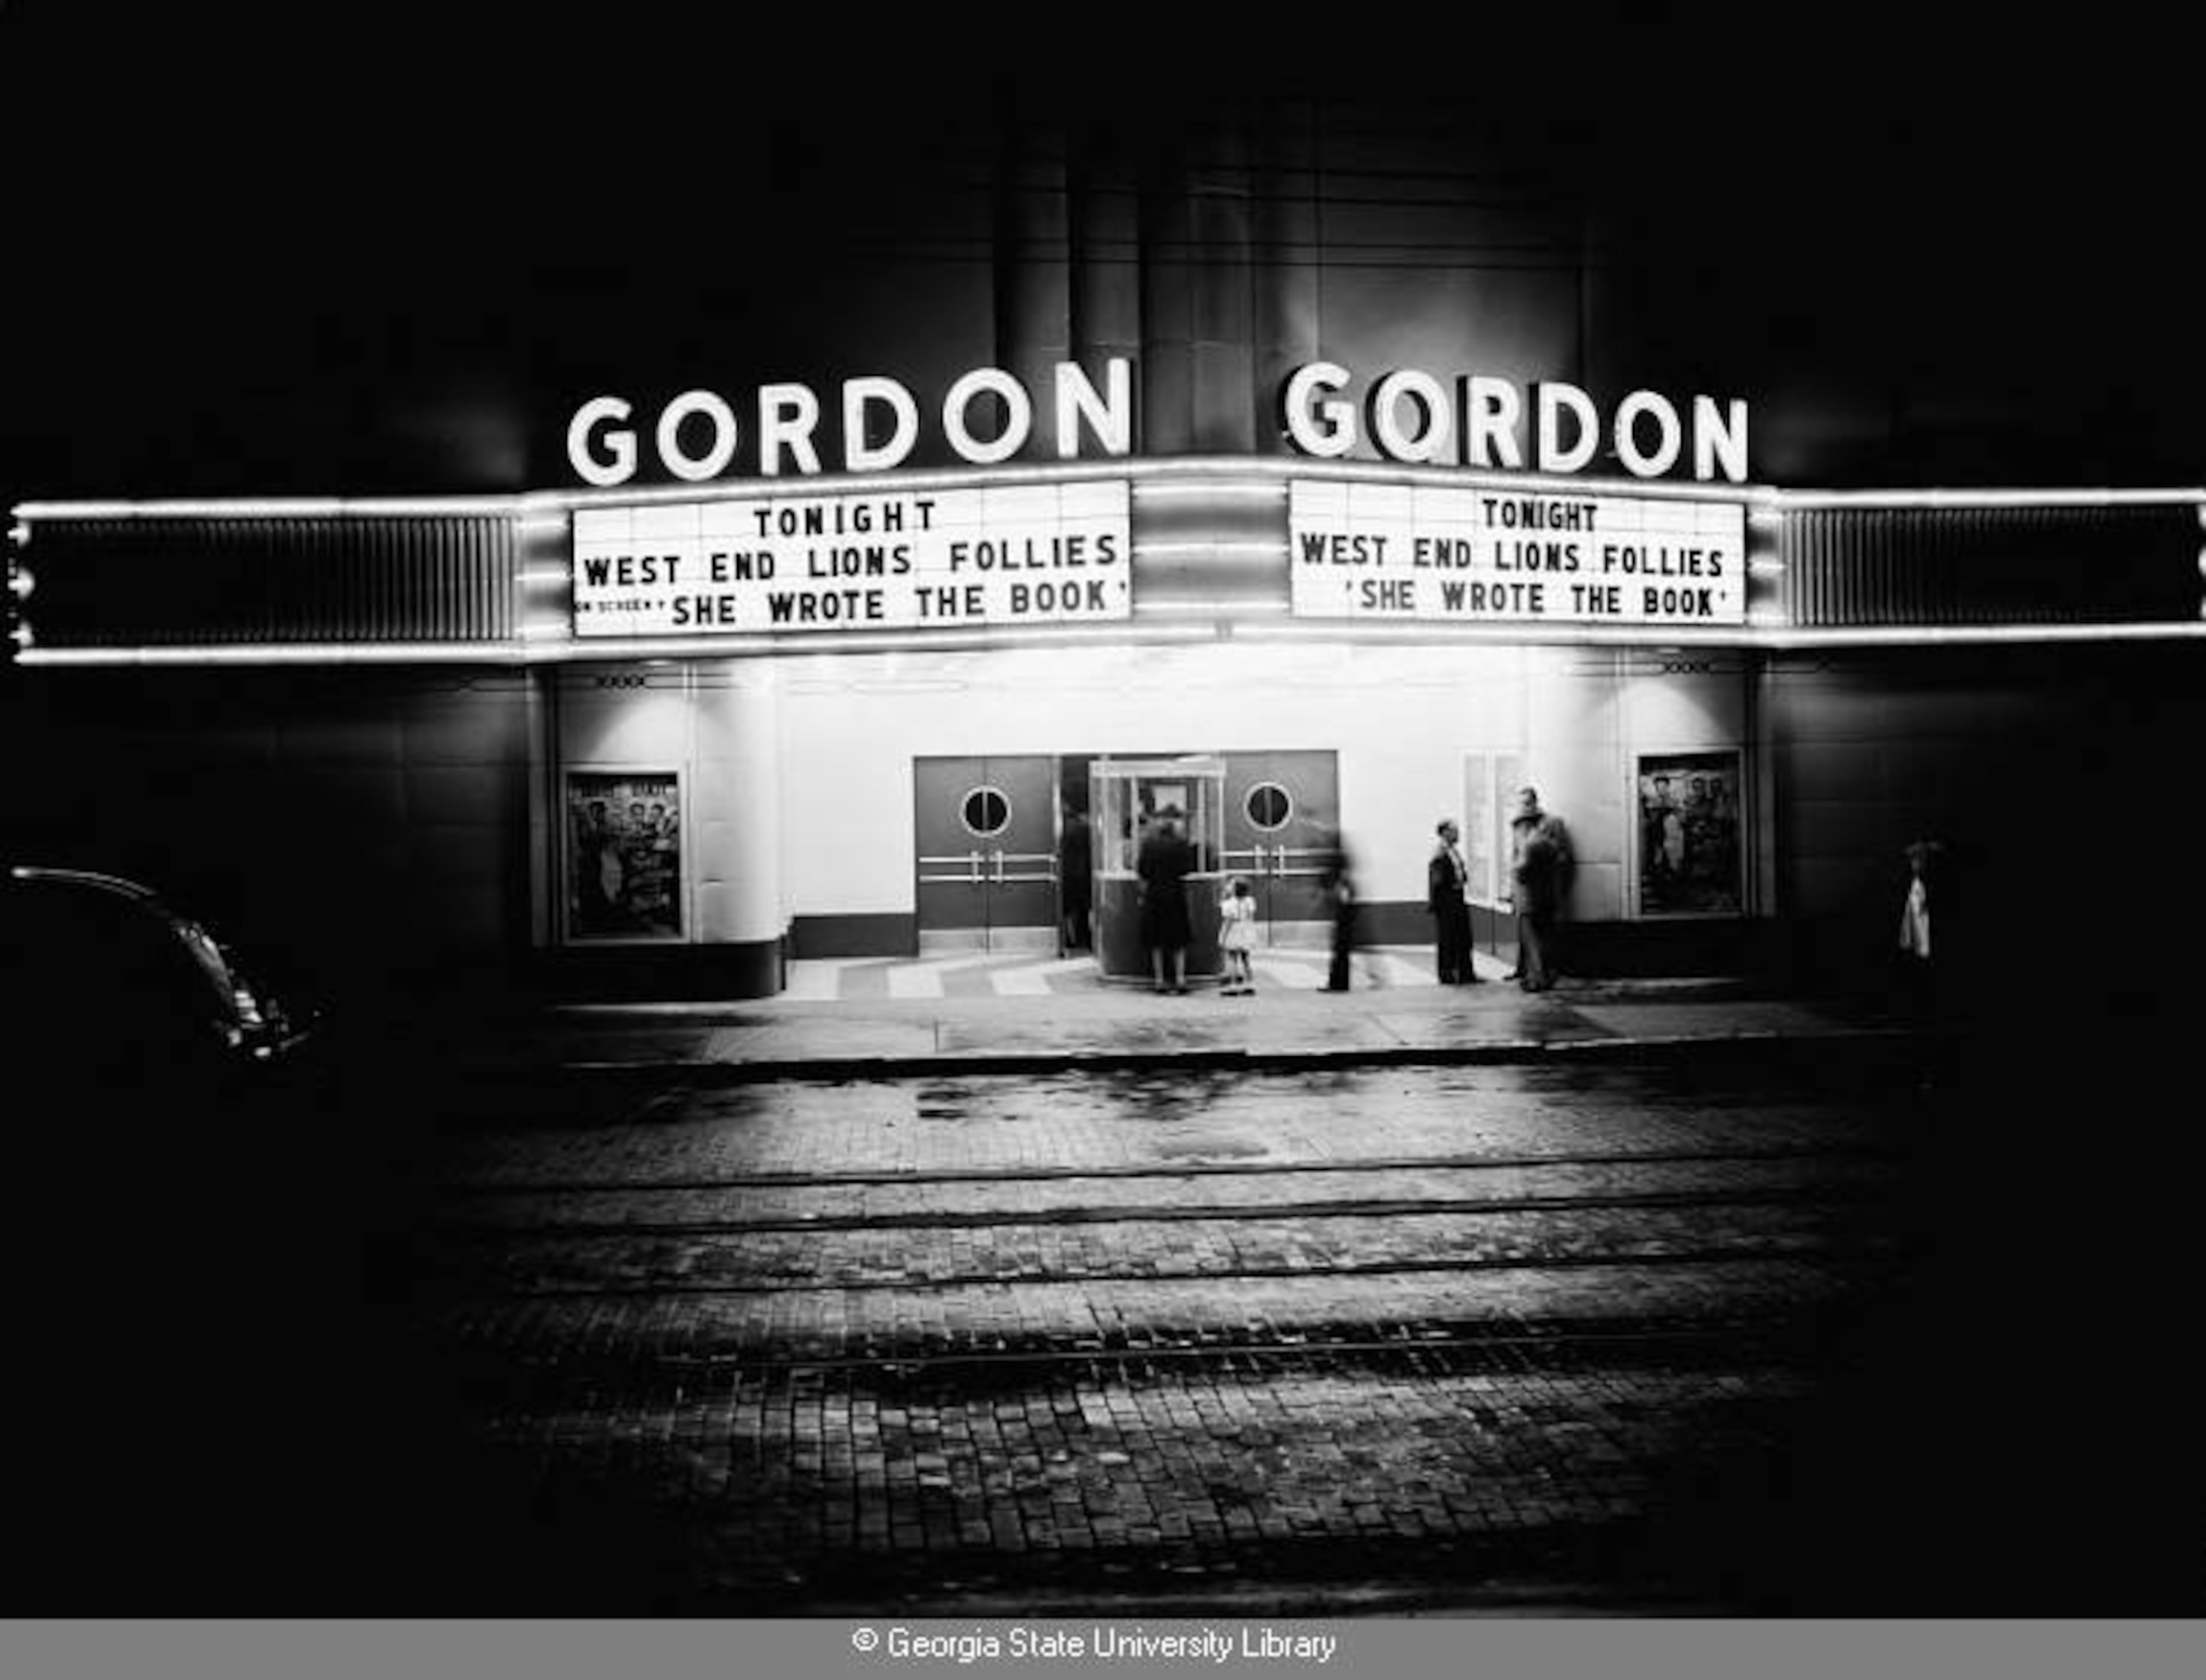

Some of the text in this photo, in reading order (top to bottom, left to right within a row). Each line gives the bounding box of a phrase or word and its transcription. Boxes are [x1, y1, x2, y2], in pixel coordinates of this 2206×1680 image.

[568, 358, 1131, 486] GORDON
[1286, 362, 1749, 482] GORDON
[754, 502, 935, 538] TONIGHT
[1483, 499, 1598, 531] TONIGHT
[584, 535, 1117, 586] WEST END LIONS FOLLIES
[1301, 533, 1723, 576] WEST END LIONS FOLLIES
[768, 590, 885, 622] WROTE
[915, 587, 985, 618] THE
[1442, 584, 1544, 612] WROTE
[1571, 585, 1621, 614] THE
